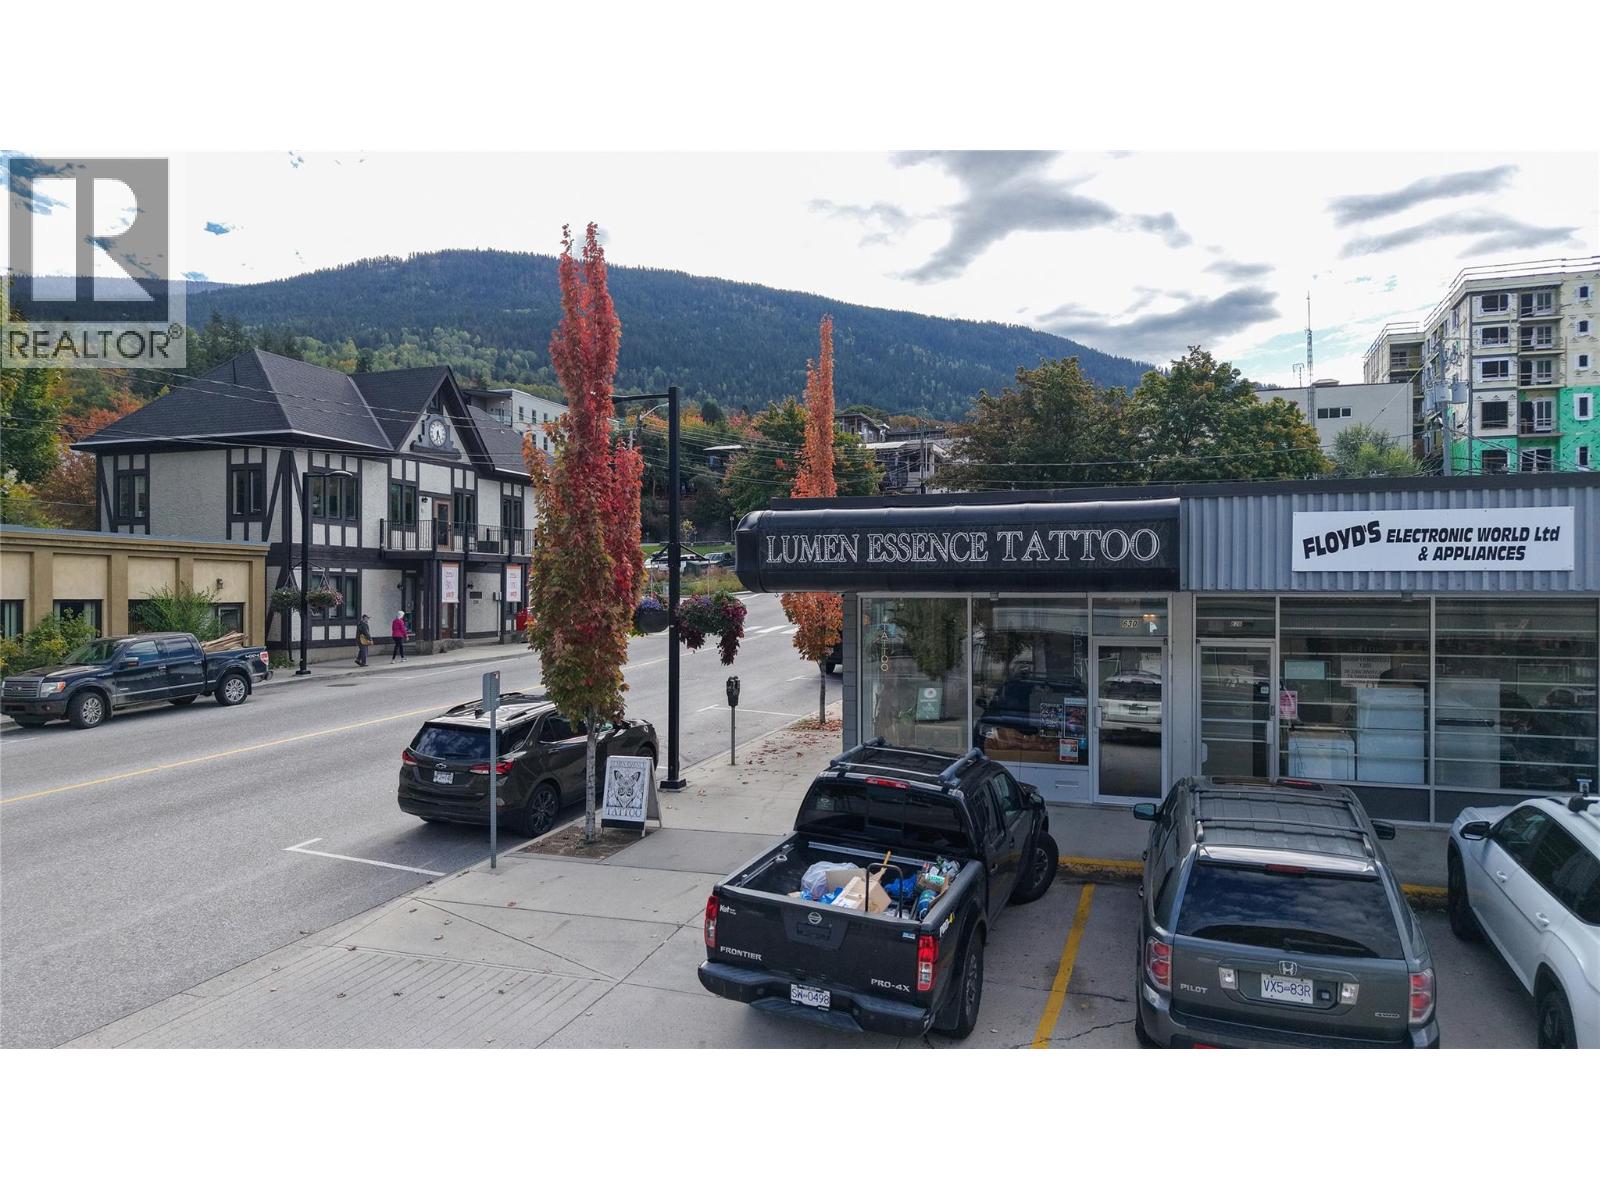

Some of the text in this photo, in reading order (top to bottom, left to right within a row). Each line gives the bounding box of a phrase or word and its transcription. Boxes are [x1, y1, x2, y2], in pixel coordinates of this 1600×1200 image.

[766, 528, 1161, 563] LUMEN ESSENCE TATTOO
[1302, 520, 1561, 560] FLOYD'S ELECTRONIC WORLD Ltd
[1418, 545, 1527, 562] & APPLIANCES
[720, 945, 763, 961] FRONTIER
[870, 978, 911, 993] PRO-4X
[1180, 982, 1209, 995] PILOT
